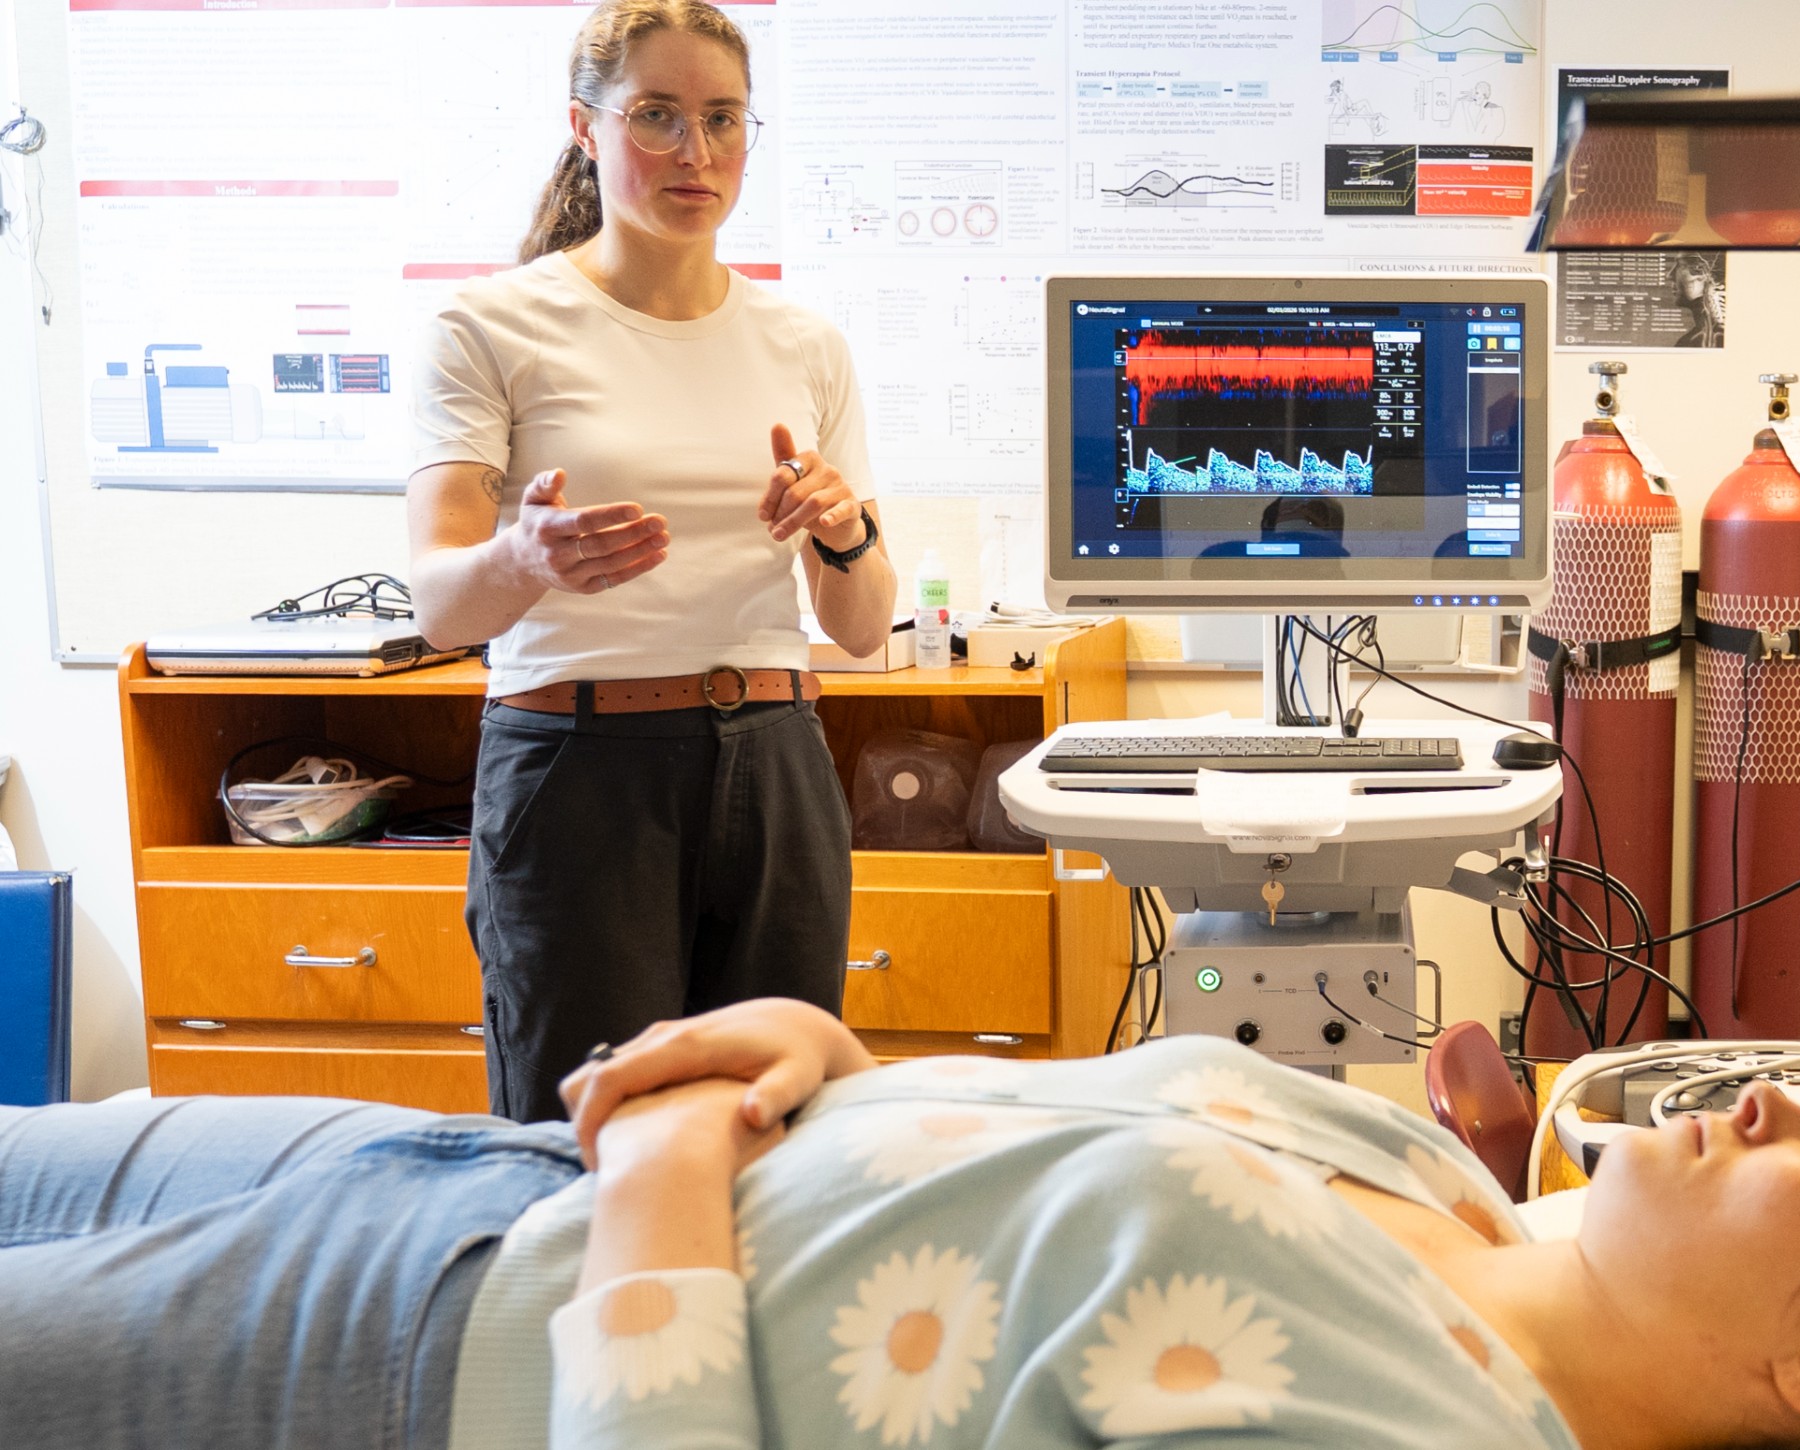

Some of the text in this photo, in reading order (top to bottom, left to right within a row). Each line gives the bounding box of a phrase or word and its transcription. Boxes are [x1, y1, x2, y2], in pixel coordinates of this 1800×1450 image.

[204, 0, 257, 9] Introduction
[1108, 71, 1151, 79] Hypercapnia
[1567, 75, 1700, 86] Transcranial Doppler Sonography
[215, 186, 257, 197] Methods
